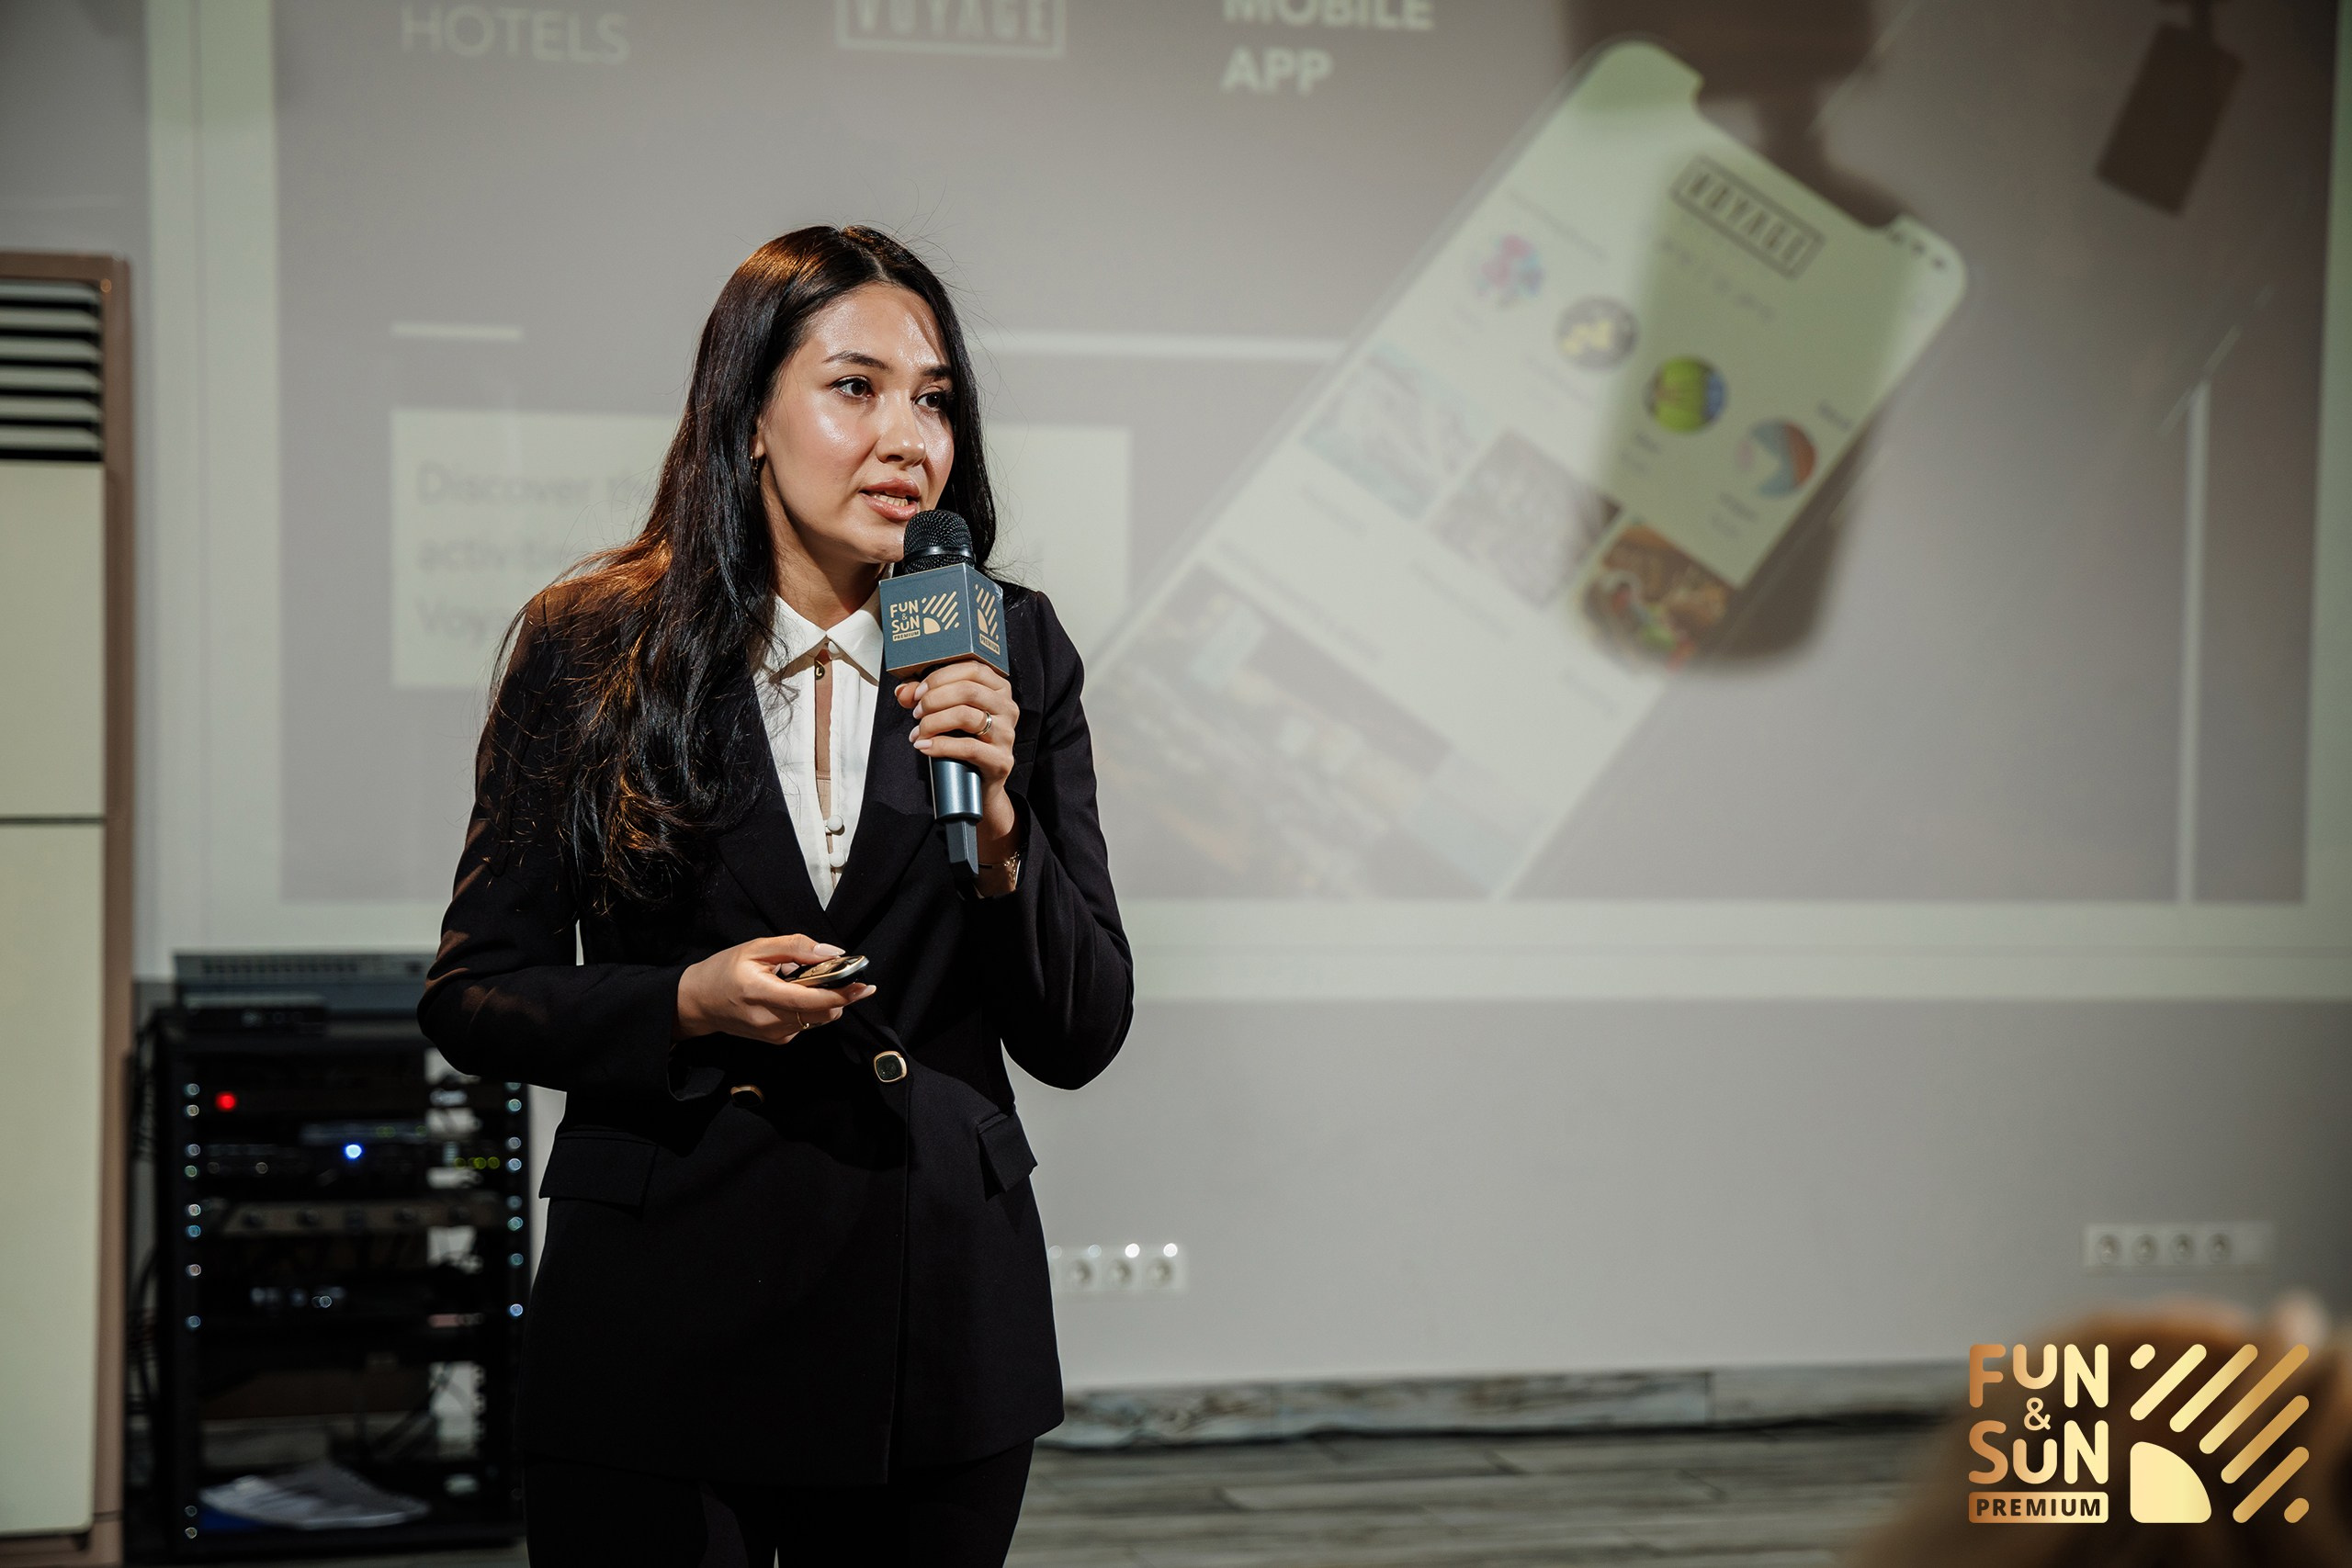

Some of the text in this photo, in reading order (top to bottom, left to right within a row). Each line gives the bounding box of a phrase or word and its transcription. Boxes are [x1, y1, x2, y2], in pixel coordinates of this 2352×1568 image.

[401, 5, 632, 64] HOTELS
[851, 0, 1052, 41] VOYAGE
[1218, 45, 1334, 94] APP
[1685, 167, 1811, 265] VOYAGE
[889, 599, 920, 619] FUN
[891, 615, 921, 634] SUN
[893, 629, 921, 641] PREMIUM
